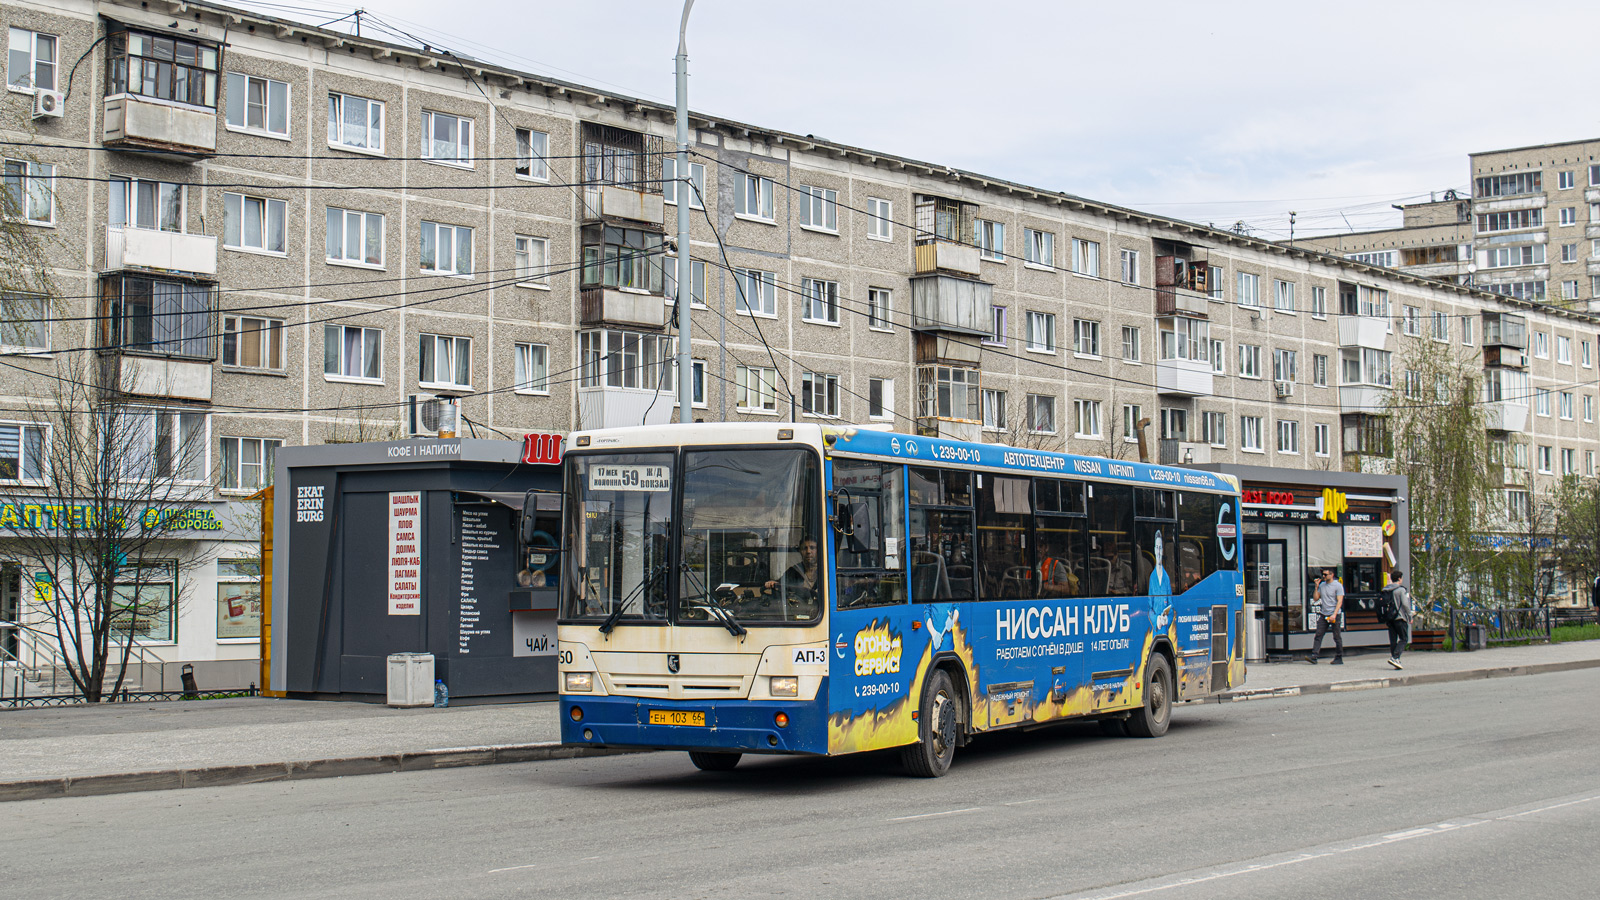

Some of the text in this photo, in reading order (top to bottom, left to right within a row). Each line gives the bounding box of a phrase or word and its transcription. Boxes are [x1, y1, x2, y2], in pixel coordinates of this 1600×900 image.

[387, 445, 410, 457] КОФЕ
[419, 443, 460, 456] НАПИТКИ
[939, 445, 980, 463] 239-00-10
[1003, 451, 1134, 478] АВТОТЕХЦЕНТР NISSAN INFINITI
[598, 467, 617, 477] 17 МЕХ
[622, 469, 638, 487] 59
[646, 467, 662, 478] Ж/Д
[1153, 469, 1215, 487] 239-00-10 nissan66.ru
[640, 479, 668, 489] ВОКЗАЛ
[297, 486, 324, 498] EKAT
[1242, 489, 1293, 505] FAST FOOD
[297, 499, 323, 510] ERIN
[392, 495, 419, 504] ШАШЛЫК
[297, 511, 324, 523] BURG
[393, 507, 417, 516] ШАУРМА
[1264, 511, 1283, 519] шаурма
[398, 520, 412, 528] ПЛОВ
[396, 532, 414, 540] САМСА
[395, 545, 415, 554] ДОЛМА
[394, 569, 416, 578] ЛАГМАН
[37, 585, 49, 596] 24
[996, 604, 1131, 641] НИССАН КЛУБ
[526, 634, 547, 652] ЧАЙ
[996, 638, 1129, 660] РАБОТАЕМ С ОГНЁМ В ДУШЕ! 14 ЛЕТ ОПЫТА!
[794, 650, 825, 663] АП-3
[855, 656, 900, 676] СЕРВИС!
[861, 682, 899, 697] 239-00-10
[1013, 690, 1029, 699] РЕМОНТ
[654, 712, 701, 724] ЕН 103 66
